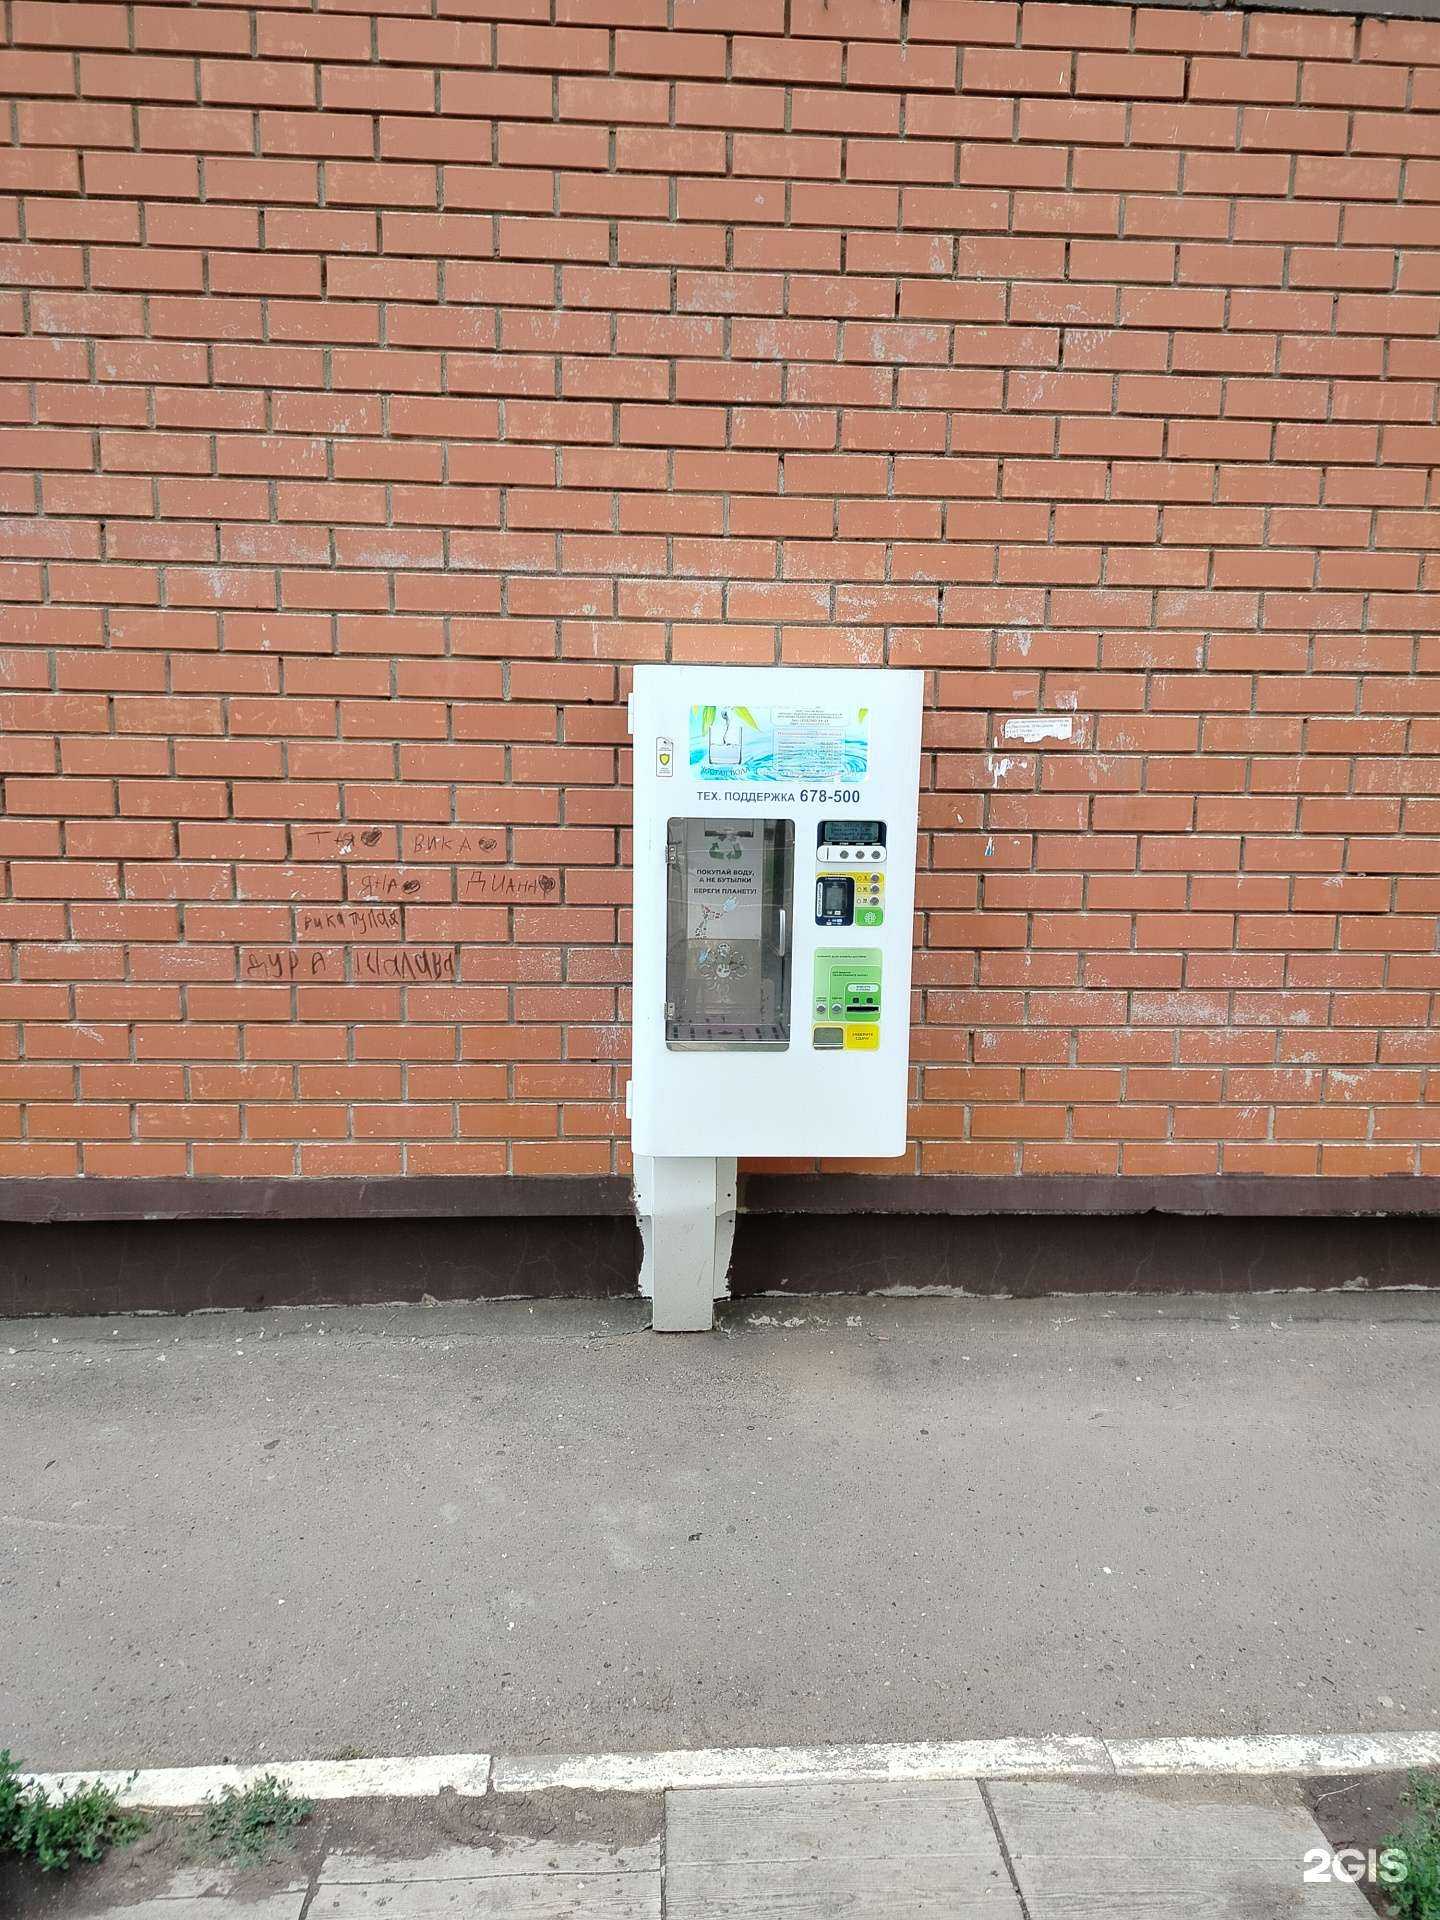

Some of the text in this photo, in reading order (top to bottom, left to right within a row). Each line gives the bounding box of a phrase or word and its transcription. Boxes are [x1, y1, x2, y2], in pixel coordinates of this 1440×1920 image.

[697, 789, 860, 803] ТЕХ. ПОДДЕРЖКА 678-500
[413, 833, 472, 853] ВИКА
[733, 869, 755, 877] ВОДУ,
